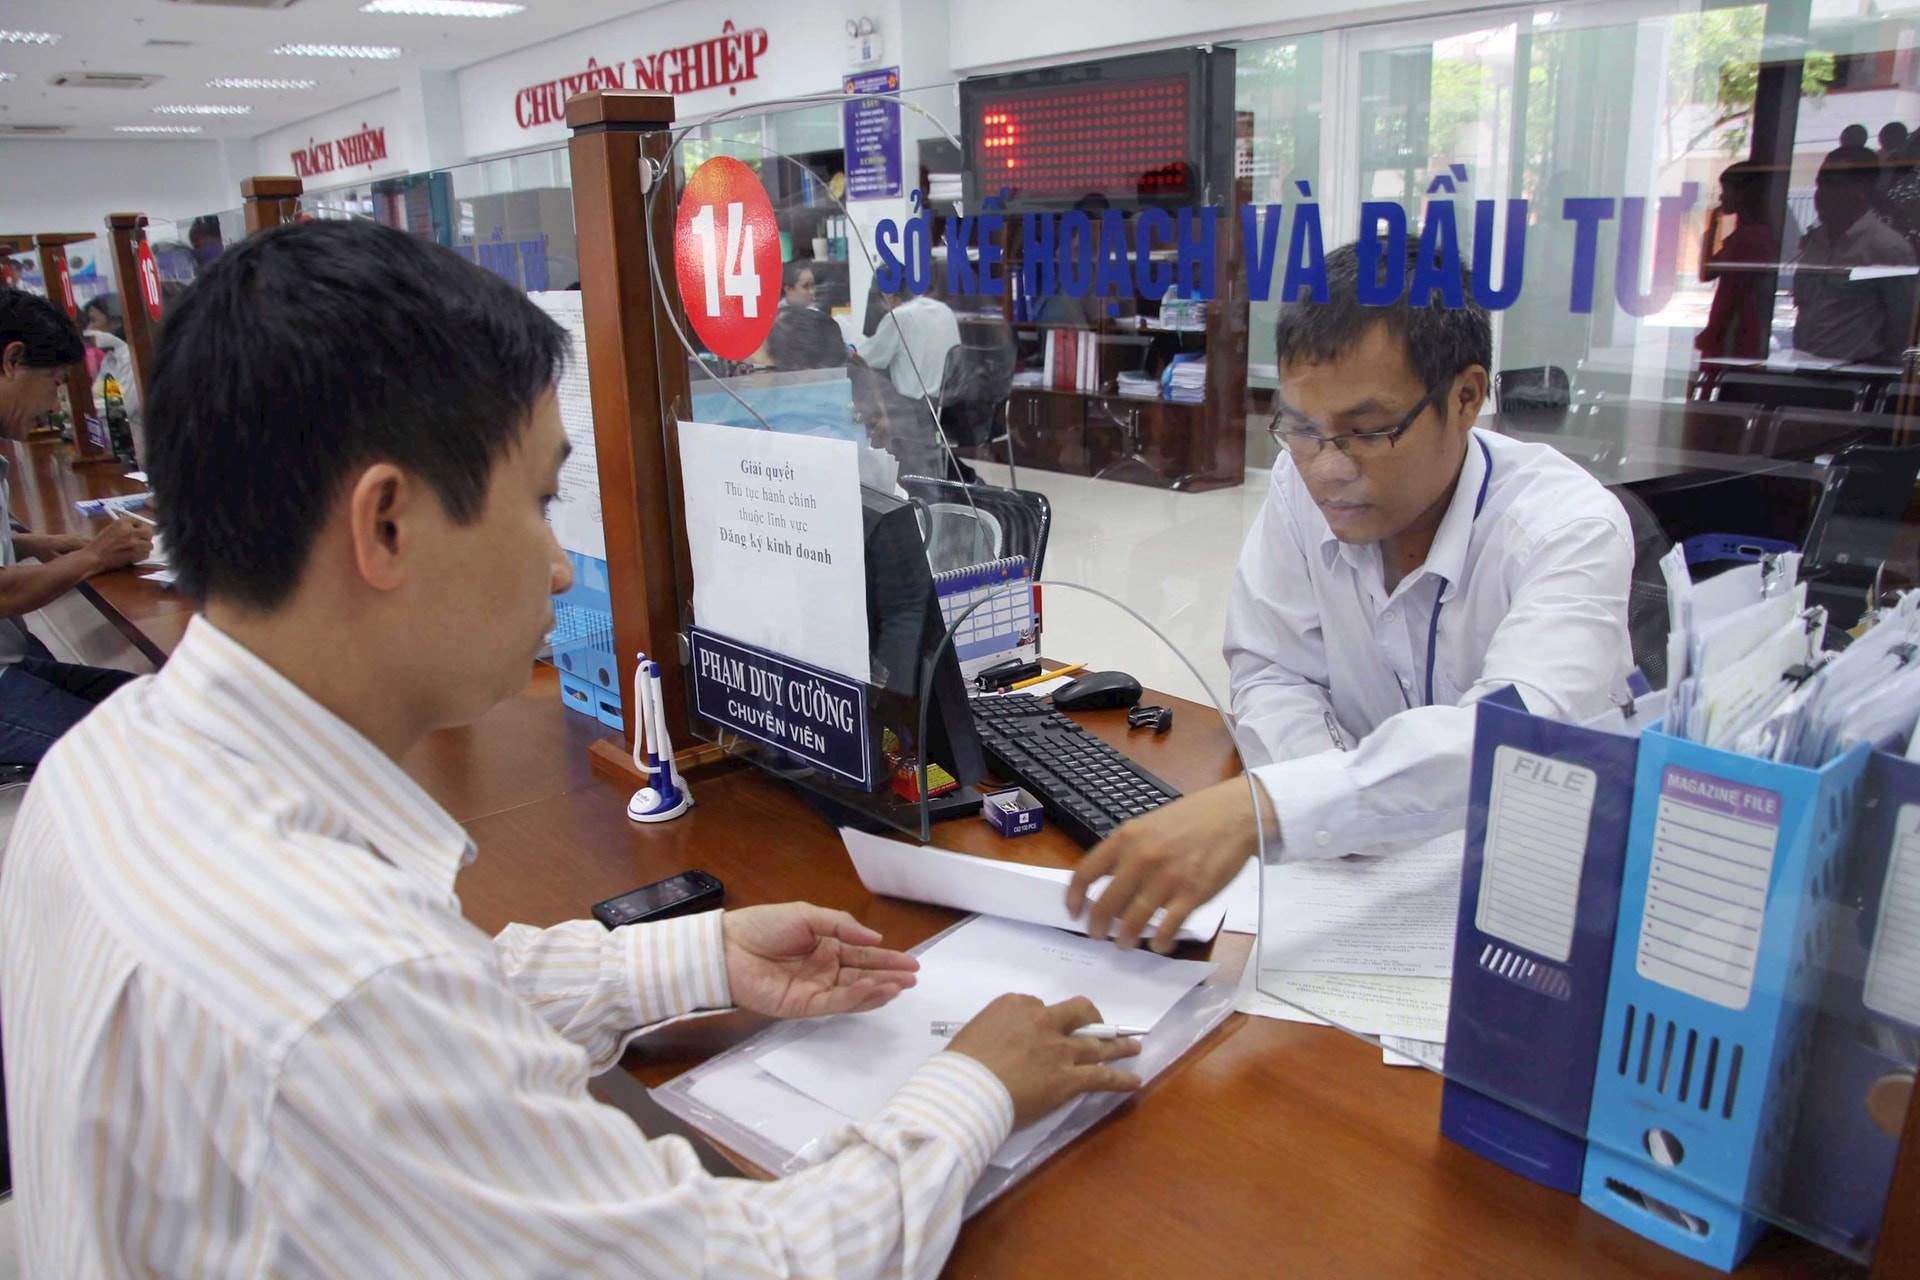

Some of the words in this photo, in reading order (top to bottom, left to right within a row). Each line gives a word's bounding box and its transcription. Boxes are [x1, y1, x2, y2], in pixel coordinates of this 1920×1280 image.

[633, 19, 768, 96] NGHIỆP
[290, 136, 335, 178] TRÁCH
[336, 122, 387, 170] NHIỆM
[692, 202, 761, 318] 14
[875, 189, 932, 295] SỞ
[946, 187, 1012, 296] KẾ
[1023, 207, 1217, 316] HOẠCH
[1241, 180, 1328, 302] VÀ
[1357, 163, 1528, 311] ĐẦU
[1562, 181, 1700, 318] TƯ
[141, 257, 160, 305] 16
[740, 459, 763, 477] Giải
[765, 461, 795, 482] quyết
[745, 486, 760, 501] tục
[762, 487, 786, 504] hành
[738, 507, 765, 526] thuộc
[789, 519, 809, 534] vực
[720, 527, 747, 549] Đăng
[749, 533, 764, 553] ký
[766, 536, 793, 556] kinh
[796, 543, 833, 565] doanh
[699, 647, 746, 694] PHẠM
[748, 664, 784, 707] DUY
[788, 678, 854, 735] CƯỜNG
[727, 700, 786, 737] CHUYÊN
[788, 723, 826, 754] VIÊN
[1511, 755, 1588, 793] FILE
[1666, 772, 1738, 807] MAGAZINE
[1742, 792, 1776, 815] FILE
